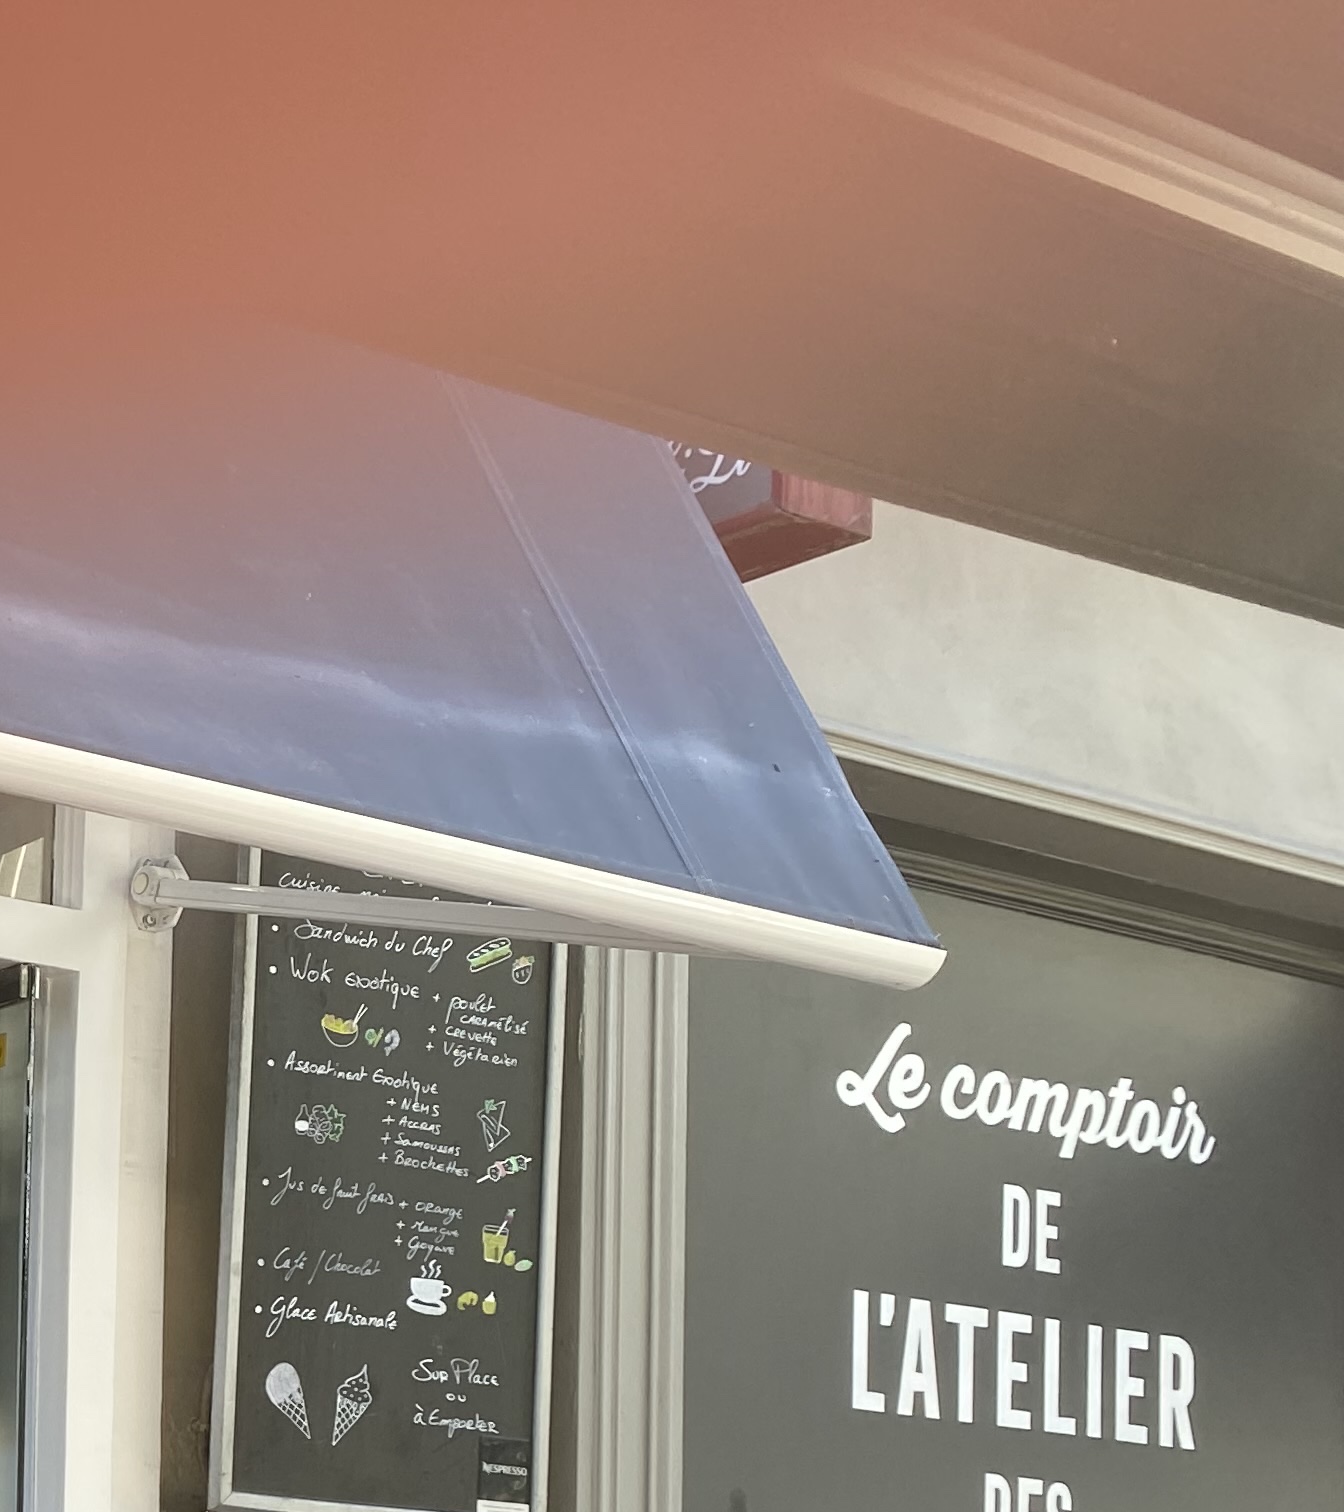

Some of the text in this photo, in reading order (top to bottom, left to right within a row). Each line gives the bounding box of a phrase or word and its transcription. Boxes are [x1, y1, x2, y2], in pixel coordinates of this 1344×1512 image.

[290, 952, 333, 983] Wok
[835, 1022, 1217, 1165] Le comptoir
[310, 1176, 327, 1194] de
[1001, 1183, 1063, 1275] DE
[851, 1288, 1197, 1451] L'ATELIER
